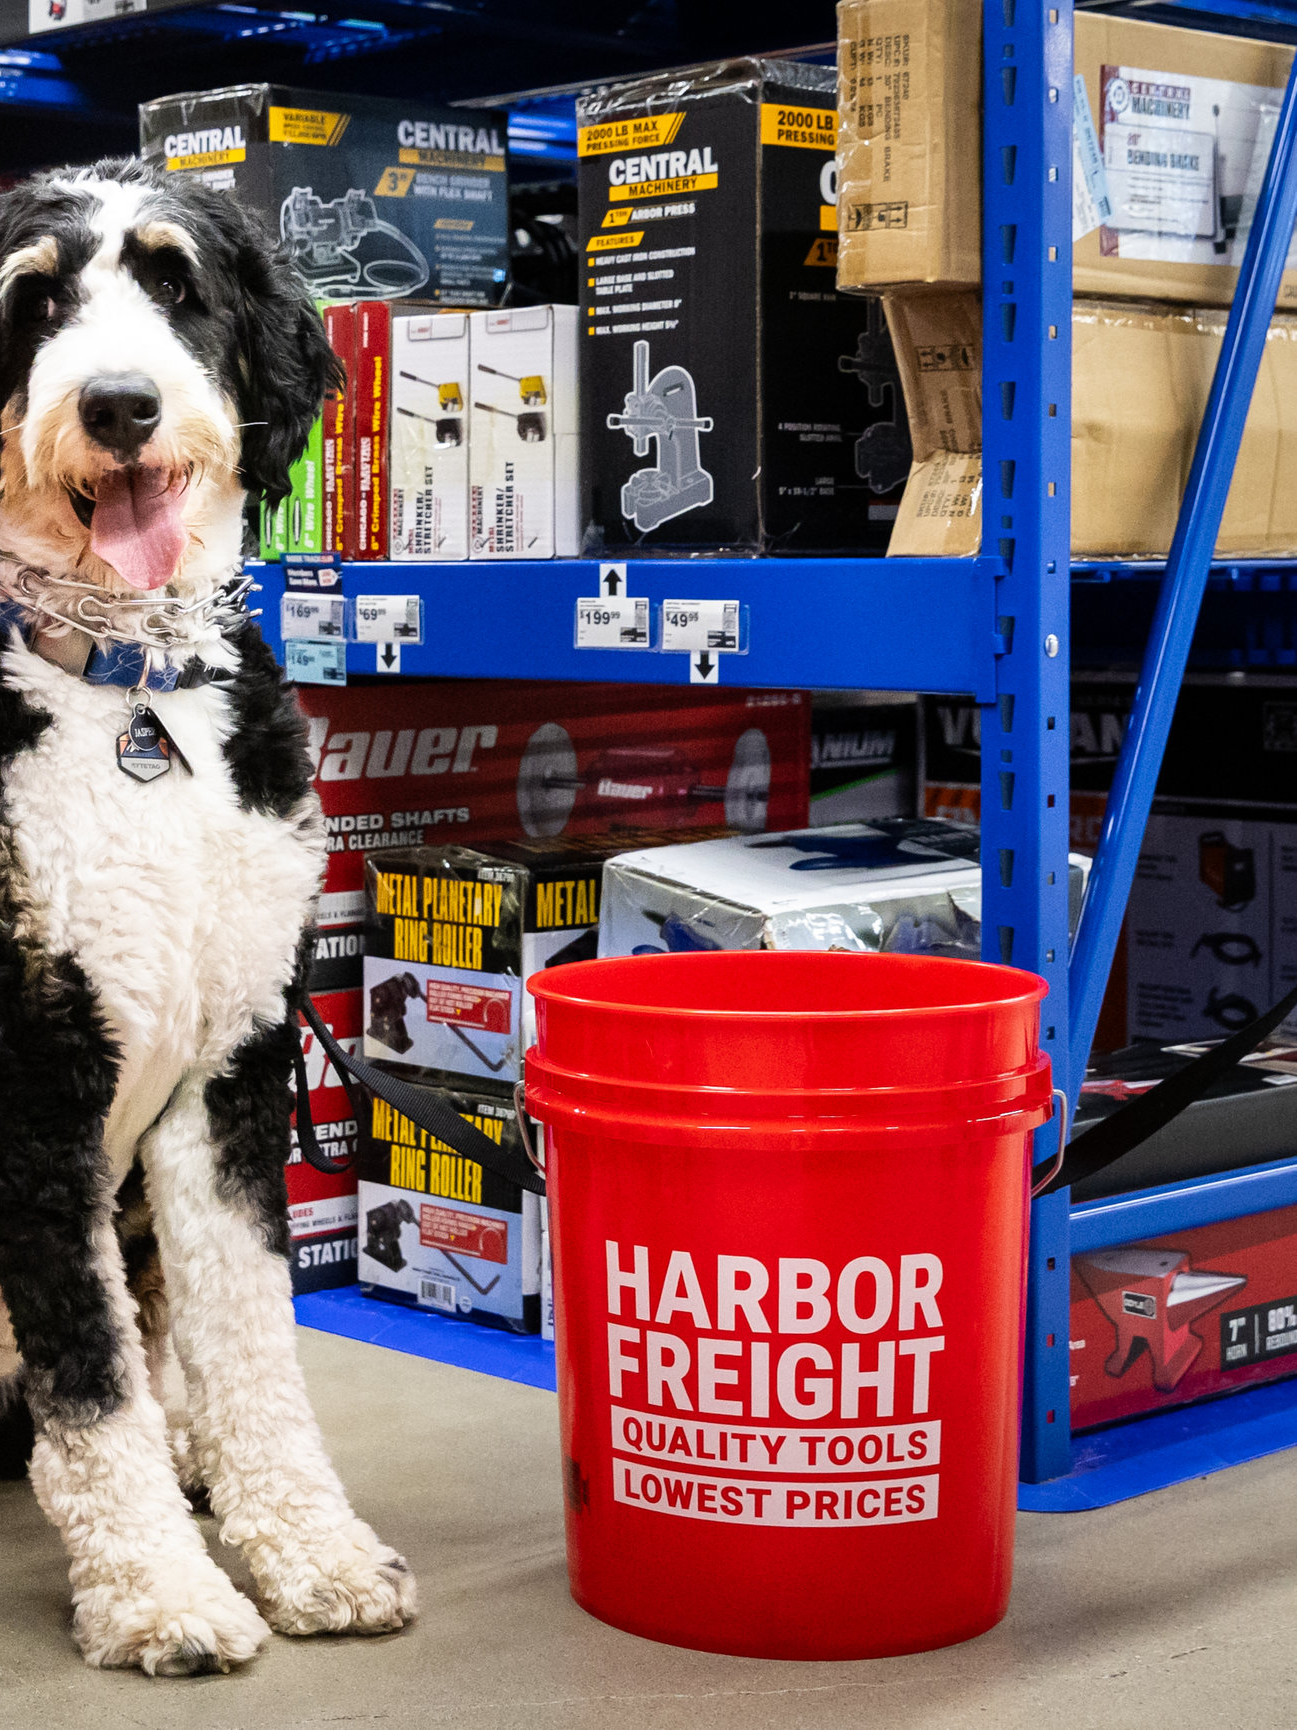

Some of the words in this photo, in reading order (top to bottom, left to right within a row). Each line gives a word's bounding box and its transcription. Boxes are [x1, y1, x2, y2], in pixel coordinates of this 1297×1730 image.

[777, 110, 812, 128] 2000
[817, 113, 834, 130] LB
[1131, 97, 1190, 120] MACHINERY
[164, 125, 246, 158] CENTRAL
[397, 120, 505, 156] CENTRAL
[586, 128, 613, 141] 2000
[615, 125, 629, 137] LB
[633, 120, 659, 135] MAX
[586, 138, 630, 152] PRESSING
[632, 132, 660, 146] FORCE
[777, 128, 835, 146] PRESSING
[418, 151, 486, 167] MACHINERY
[609, 147, 719, 187] CENTRAL
[883, 146, 891, 182] BRAKE
[628, 178, 697, 197] MACHINERY
[631, 207, 663, 220] ARBOR
[664, 203, 696, 217] PRESS
[596, 236, 634, 246] FEATURES
[372, 356, 383, 399] Wheel
[335, 402, 344, 434] Wire
[372, 401, 381, 432] Wire
[335, 437, 344, 475] Brass
[371, 435, 380, 474] Brass
[505, 461, 514, 482] SET
[305, 459, 315, 499] Wheel
[425, 466, 433, 485] SET
[305, 502, 315, 531] Wire
[335, 478, 344, 533] Crimped
[359, 497, 367, 550] CHICAGO
[371, 476, 380, 533] Crimped
[415, 491, 424, 554] SHRINKER/
[424, 489, 433, 554] STRETCHER
[496, 488, 504, 552] SHRINKER/
[505, 485, 514, 552] STRETCHER
[390, 807, 470, 828] SHAFTS
[348, 829, 425, 850] CLEARANCE
[376, 872, 419, 917] METAL
[423, 876, 503, 928] PLANETARY
[536, 879, 599, 928] METAL
[394, 917, 428, 961] RING
[432, 923, 483, 971] ROLLER
[390, 1144, 426, 1193] RING
[430, 1149, 483, 1205] ROLLER
[605, 1239, 944, 1334] HARBOR
[606, 1321, 946, 1421] FREIGHT
[622, 1417, 788, 1465] QUALITY
[798, 1430, 928, 1466] TOOLS
[624, 1468, 772, 1518] LOWEST
[786, 1484, 926, 1520] PRICES
